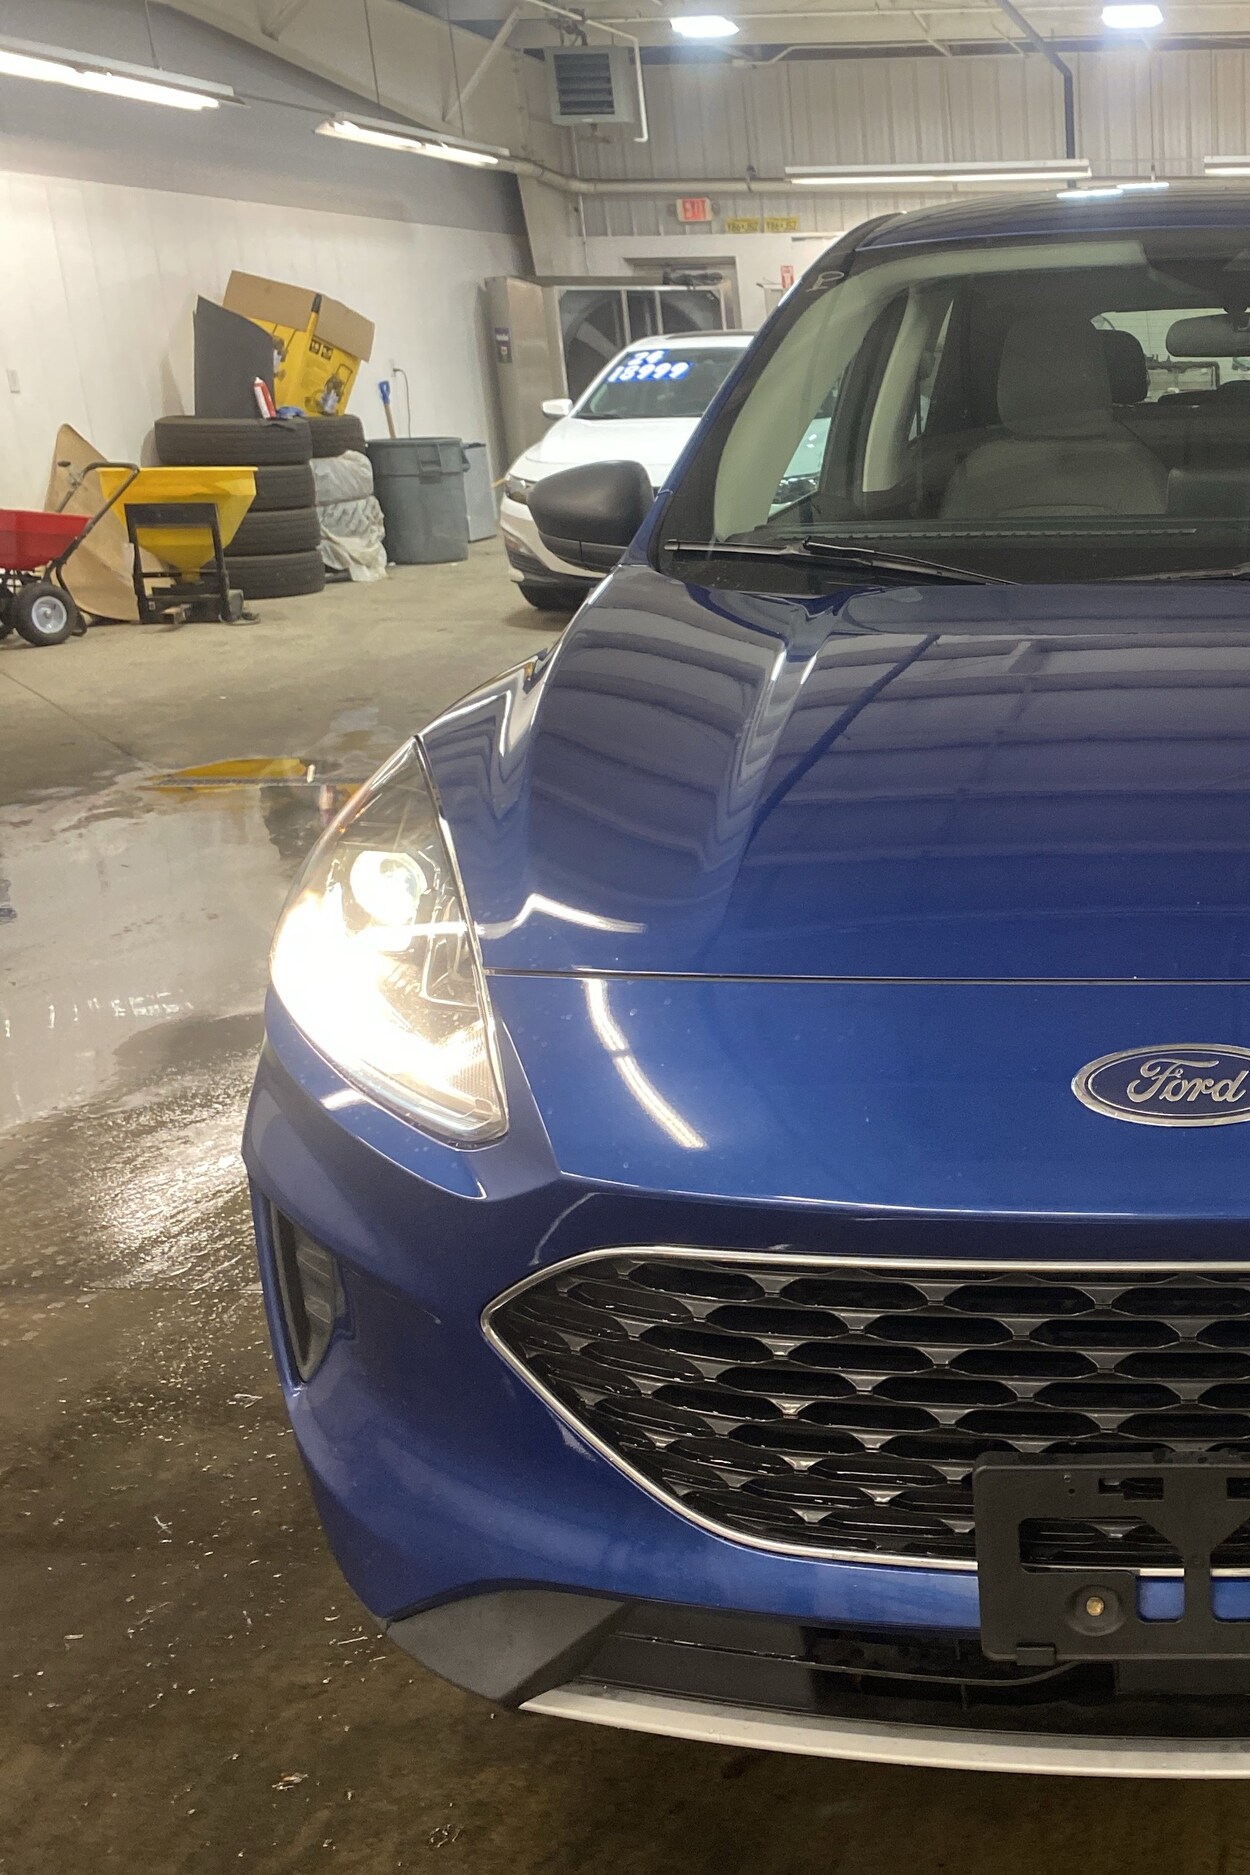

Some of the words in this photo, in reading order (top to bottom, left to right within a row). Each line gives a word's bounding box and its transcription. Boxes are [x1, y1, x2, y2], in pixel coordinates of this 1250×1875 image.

[682, 199, 706, 220] EXIT
[607, 362, 689, 381] 18999
[1127, 1058, 1249, 1103] Ford
